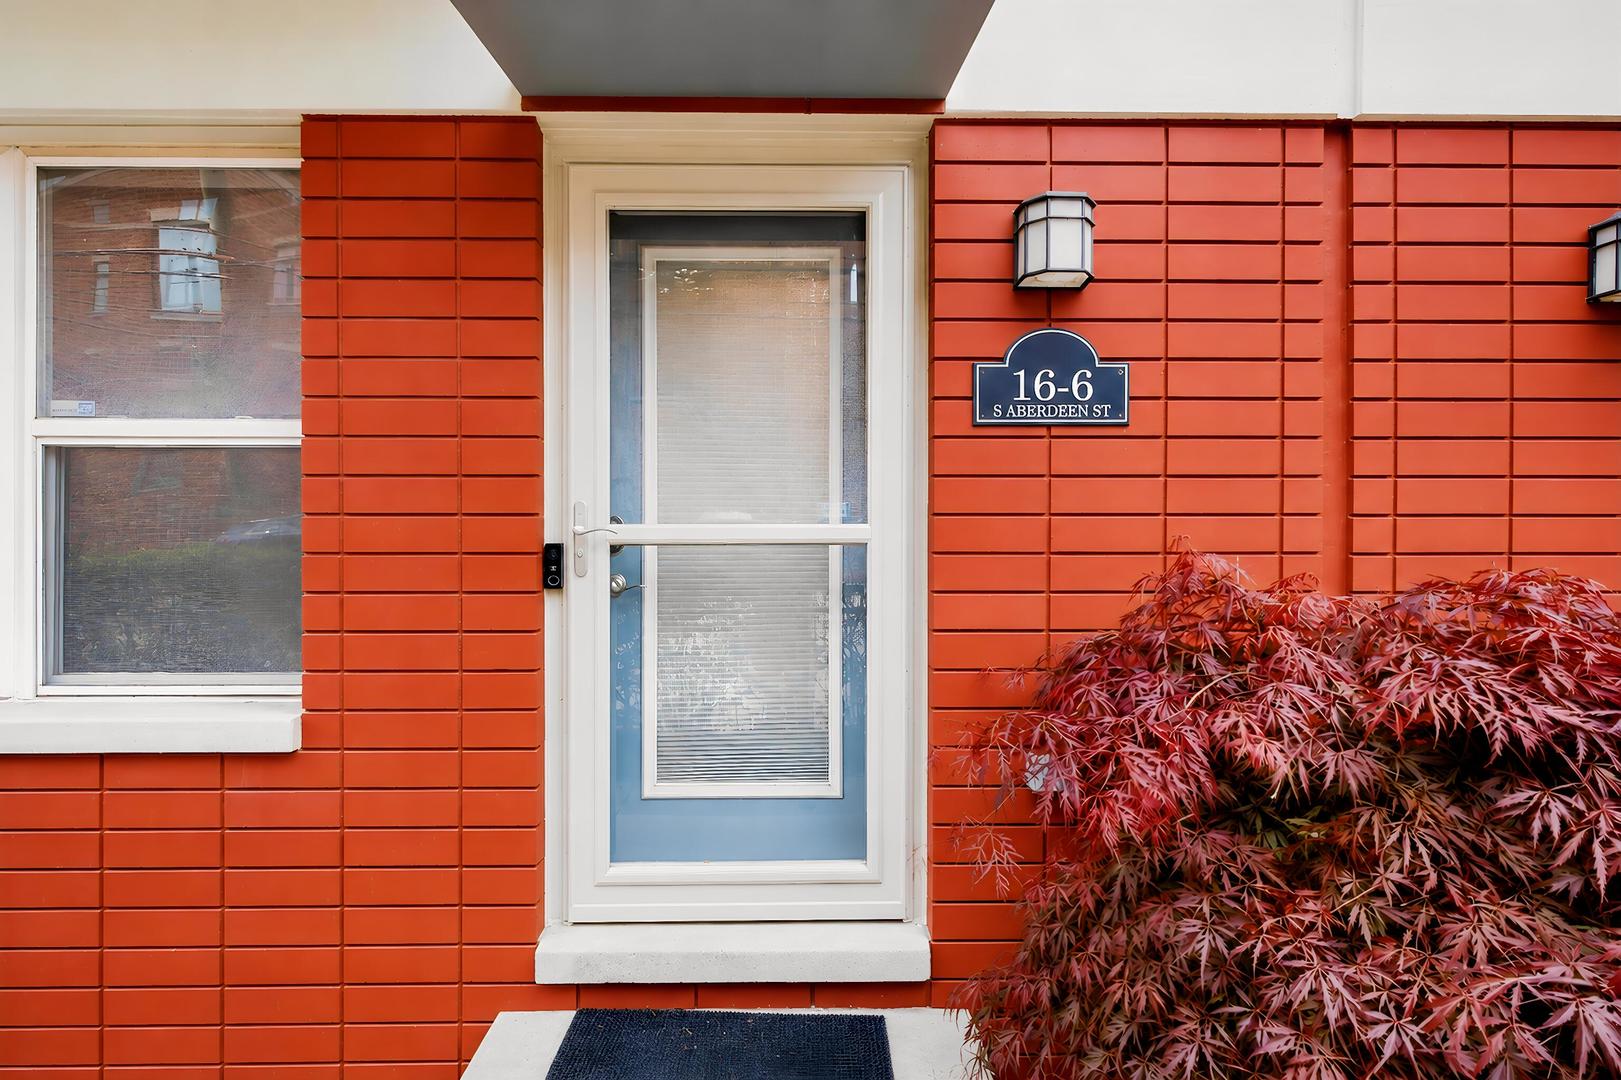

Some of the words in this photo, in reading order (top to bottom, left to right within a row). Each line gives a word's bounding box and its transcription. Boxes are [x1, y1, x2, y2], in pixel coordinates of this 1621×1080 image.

[1013, 369, 1093, 401] 16-6
[994, 404, 1002, 417] S
[1006, 404, 1088, 417] ABERDEEN
[1093, 404, 1111, 417] ST
